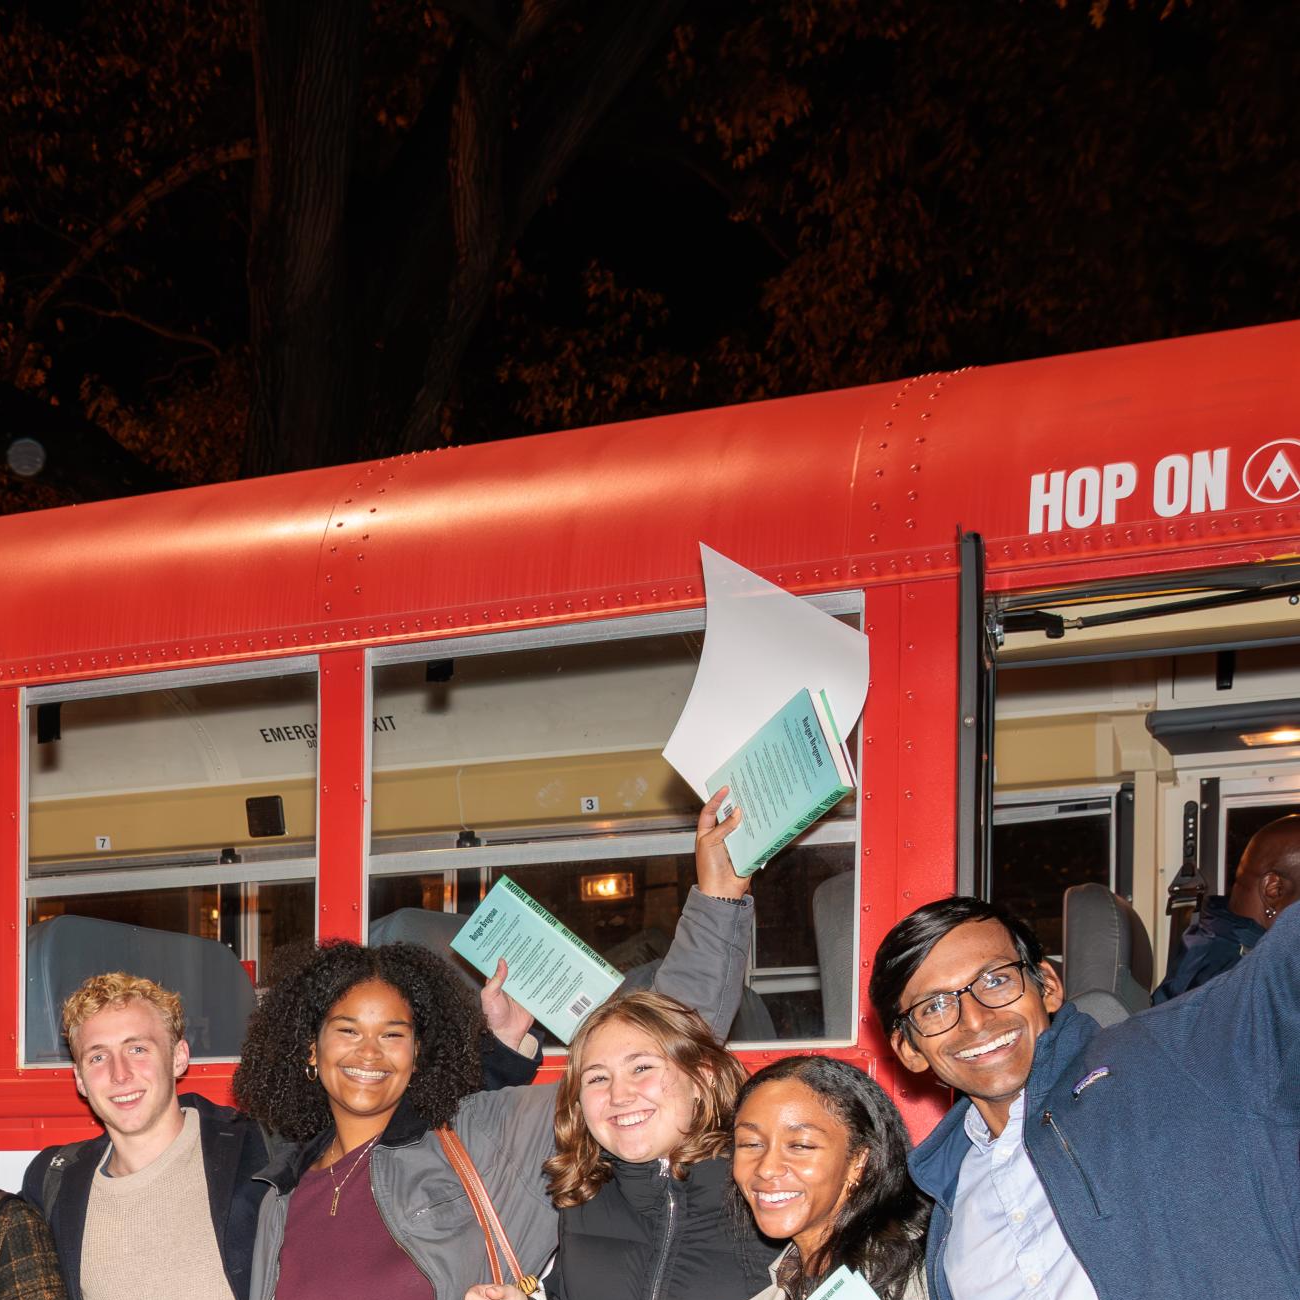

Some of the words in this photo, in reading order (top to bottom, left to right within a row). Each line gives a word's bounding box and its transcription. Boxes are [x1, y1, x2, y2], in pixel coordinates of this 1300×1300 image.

[1028, 461, 1138, 535] HOP
[1153, 447, 1230, 517] ON
[260, 723, 318, 743] EMERG
[373, 716, 397, 732] XIT
[802, 716, 812, 739] Rutger
[810, 737, 823, 768] Bregman
[586, 799, 594, 810] 3
[820, 789, 847, 809] MORAL
[794, 806, 824, 830] AMBITION
[99, 838, 106, 848] 7
[469, 926, 484, 941] Rutger
[480, 908, 498, 928] Bregman
[505, 881, 527, 902] MORAL
[526, 899, 558, 928] AMBITION
[561, 927, 583, 949] RUTGER
[580, 944, 607, 969] BREGMAN
